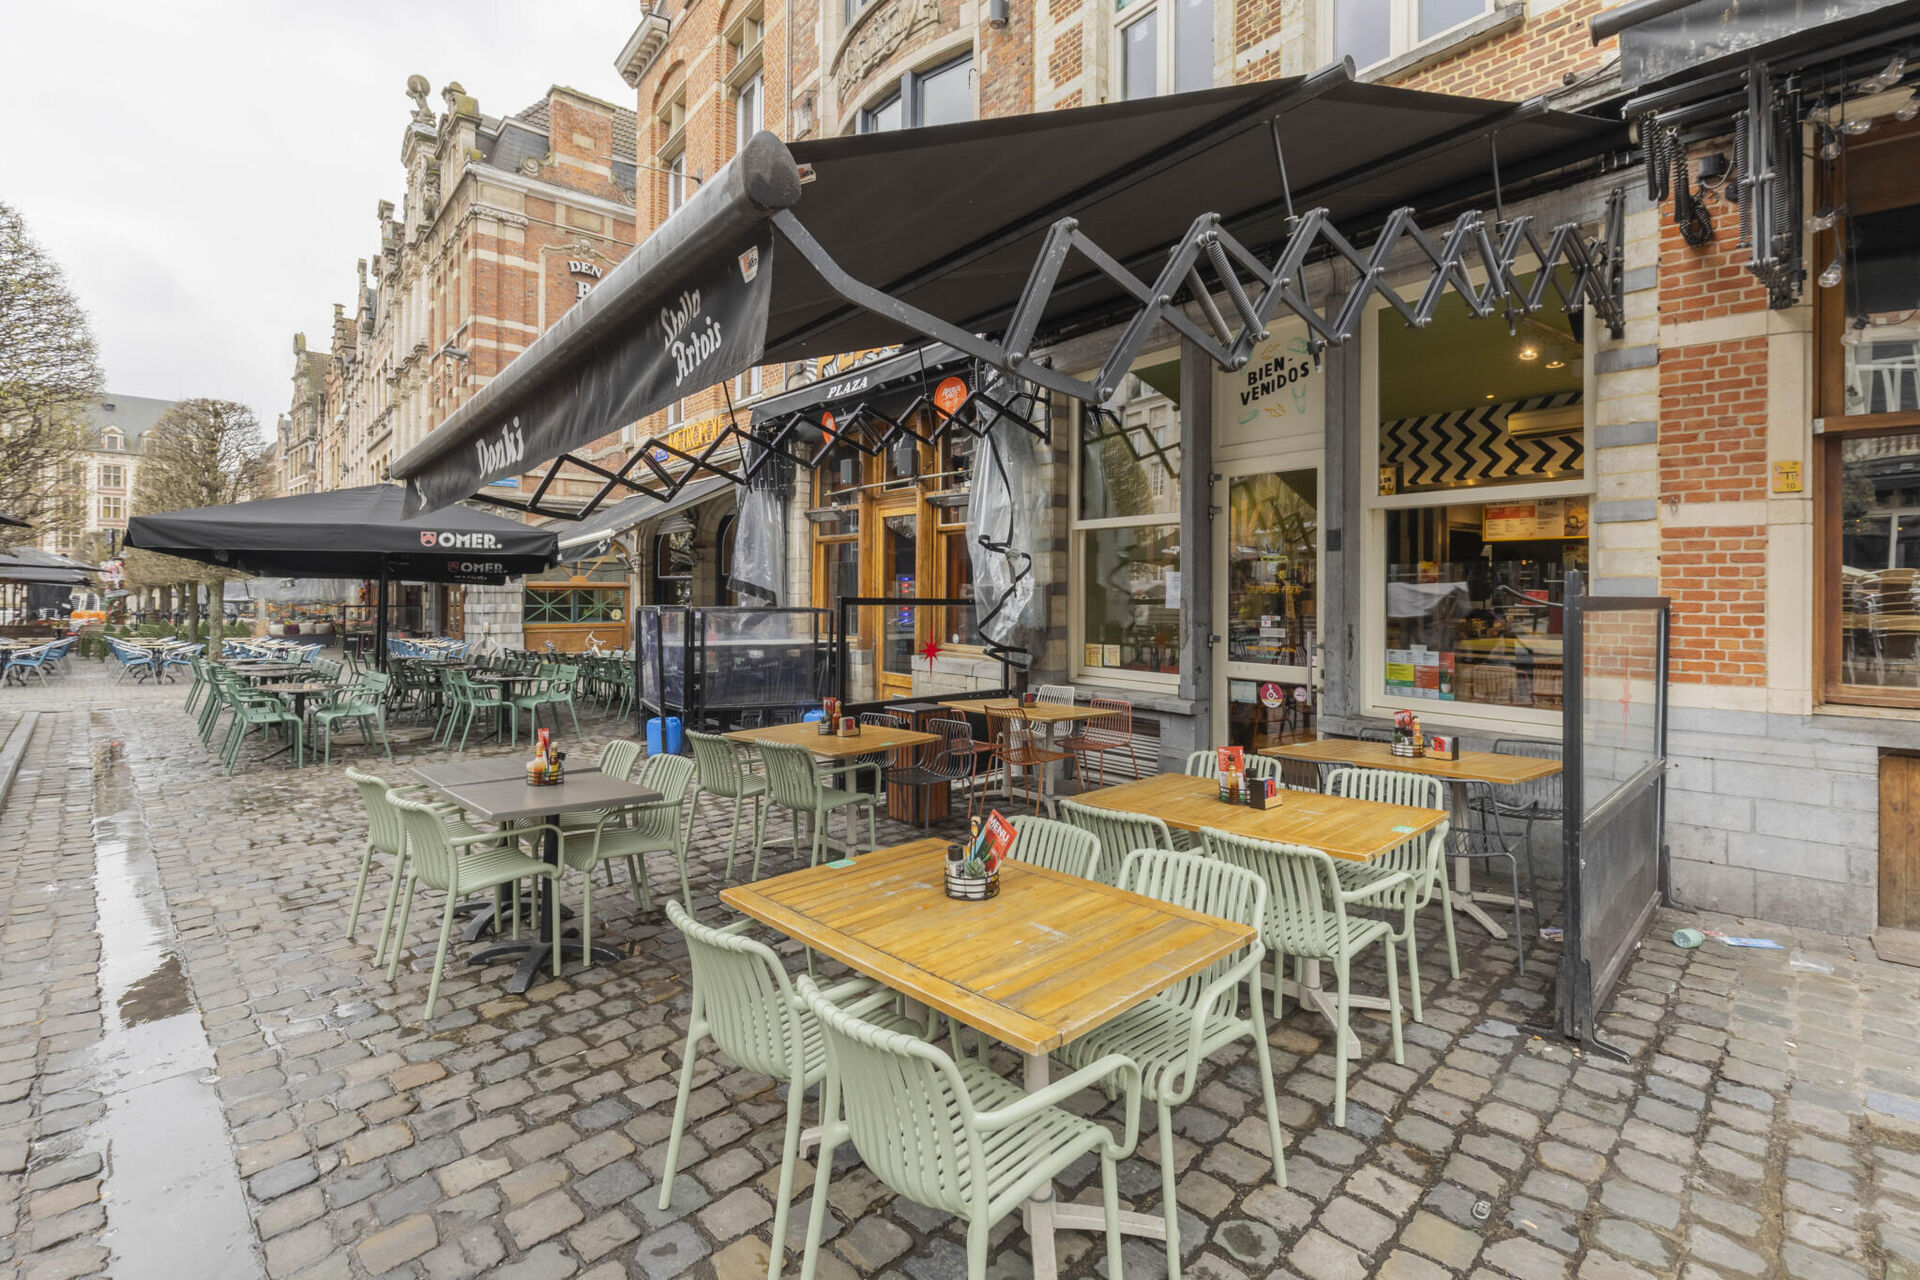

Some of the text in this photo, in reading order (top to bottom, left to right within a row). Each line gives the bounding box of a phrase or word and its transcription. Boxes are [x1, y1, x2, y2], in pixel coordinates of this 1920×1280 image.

[568, 260, 603, 279] DEN
[661, 289, 701, 352] Stella
[671, 316, 722, 387] Artois
[827, 376, 868, 399] PLAZA
[1240, 362, 1310, 406] VENIDOS
[476, 416, 525, 479] Donki
[438, 532, 503, 549] OMER.
[989, 815, 1010, 842] MENU
